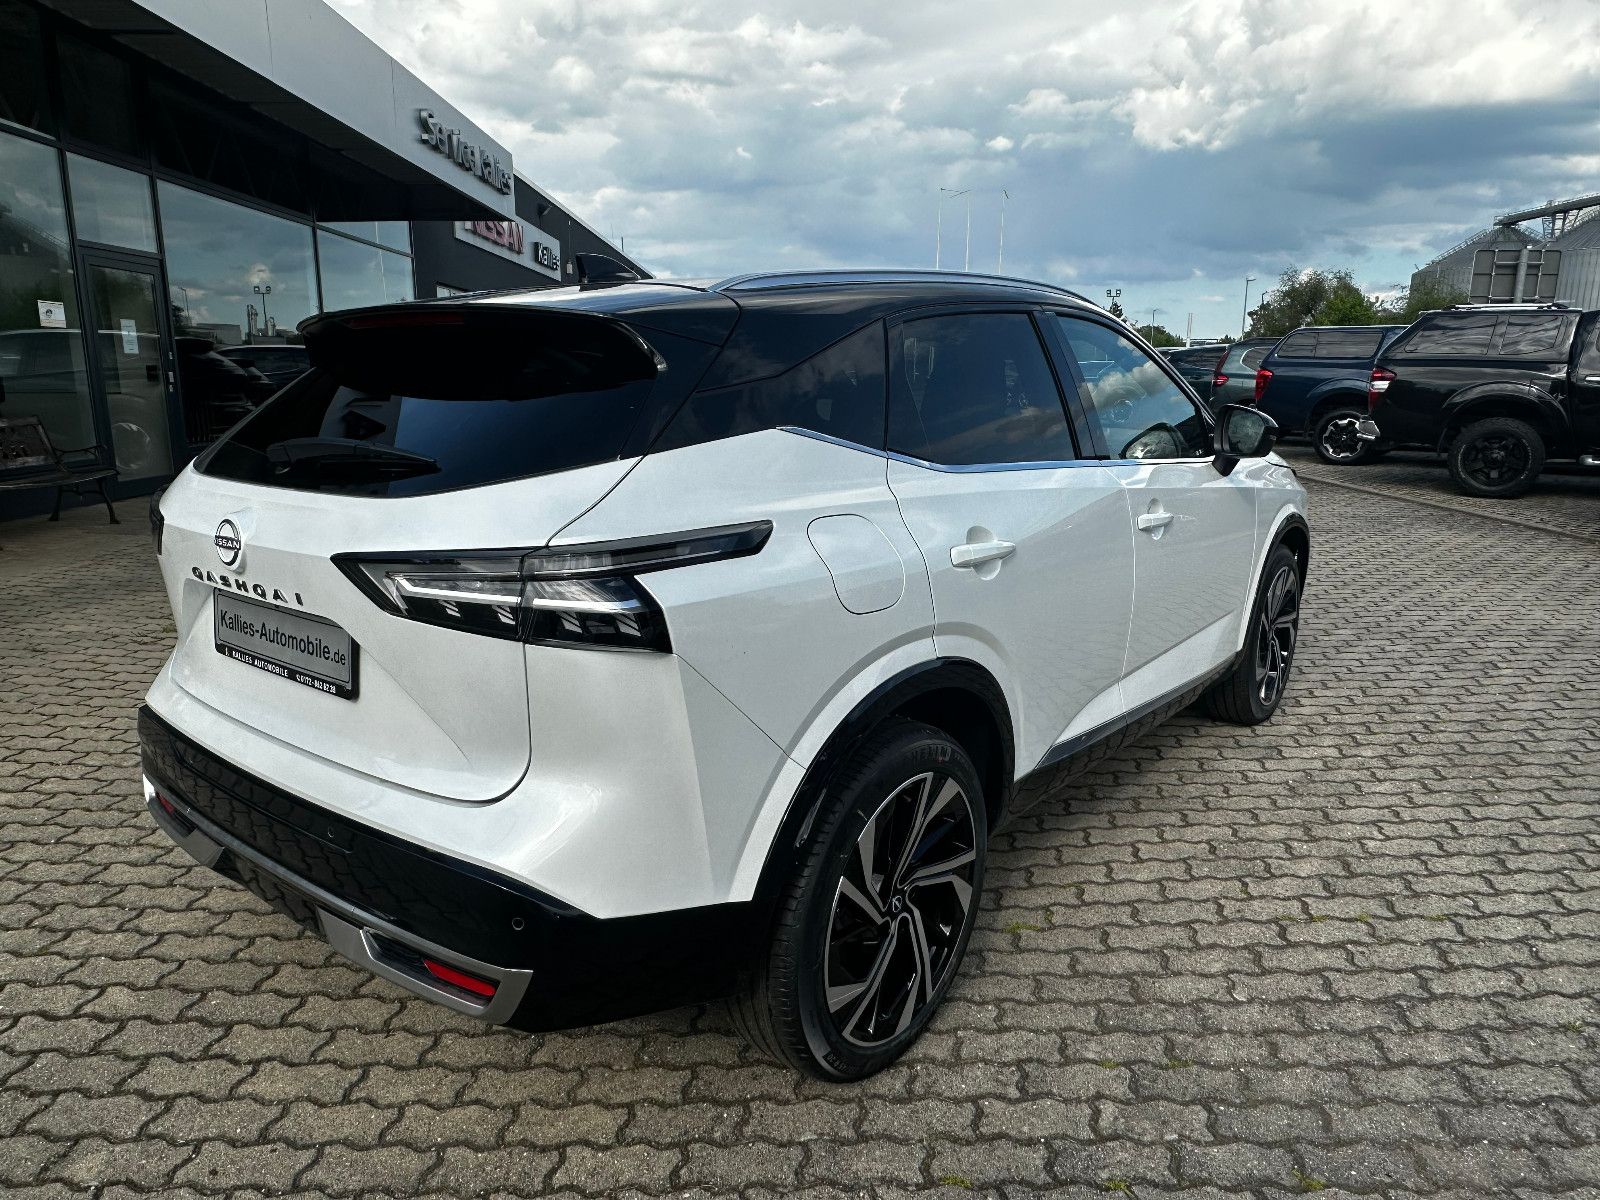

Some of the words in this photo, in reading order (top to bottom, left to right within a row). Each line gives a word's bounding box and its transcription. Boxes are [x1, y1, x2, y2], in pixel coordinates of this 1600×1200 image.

[419, 109, 475, 172] Service
[535, 241, 560, 271] Kallies
[191, 566, 304, 606] QASHQAI
[219, 609, 347, 666] Kallies-Automobile.de
[232, 650, 253, 664] KALLIES
[254, 659, 289, 677] AUTOMOBILE
